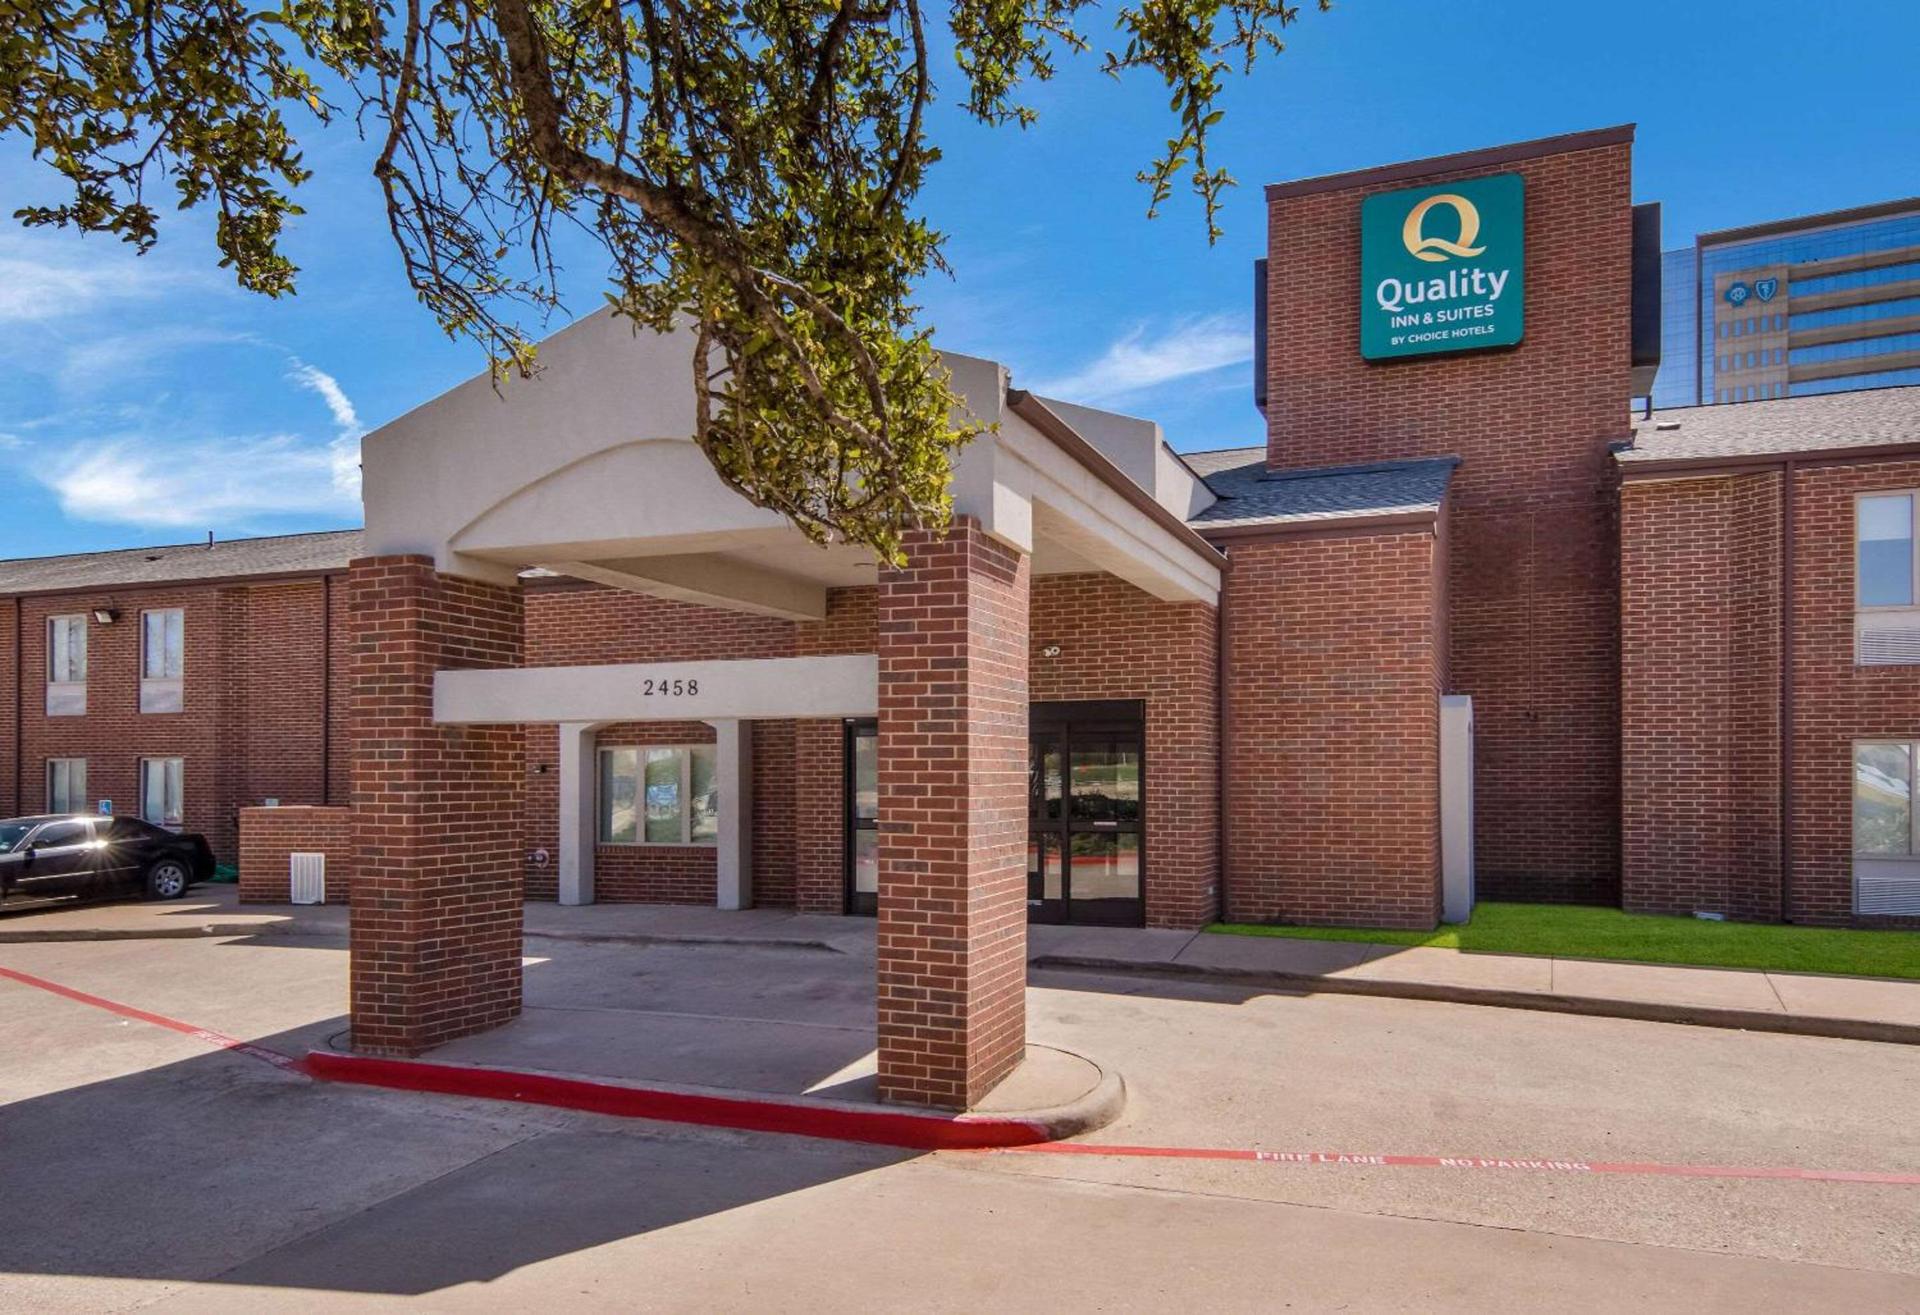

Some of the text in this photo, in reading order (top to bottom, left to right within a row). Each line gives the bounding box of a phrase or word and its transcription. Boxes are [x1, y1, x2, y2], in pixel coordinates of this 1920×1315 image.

[1403, 194, 1487, 262] Q
[1376, 268, 1510, 312] Quality
[1391, 304, 1494, 328] INN & SUITES
[1391, 325, 1495, 345] BY CHOICE HOTELS
[643, 679, 699, 696] 2458
[1256, 1151, 1591, 1171] FIRE LANE NO PARKING
